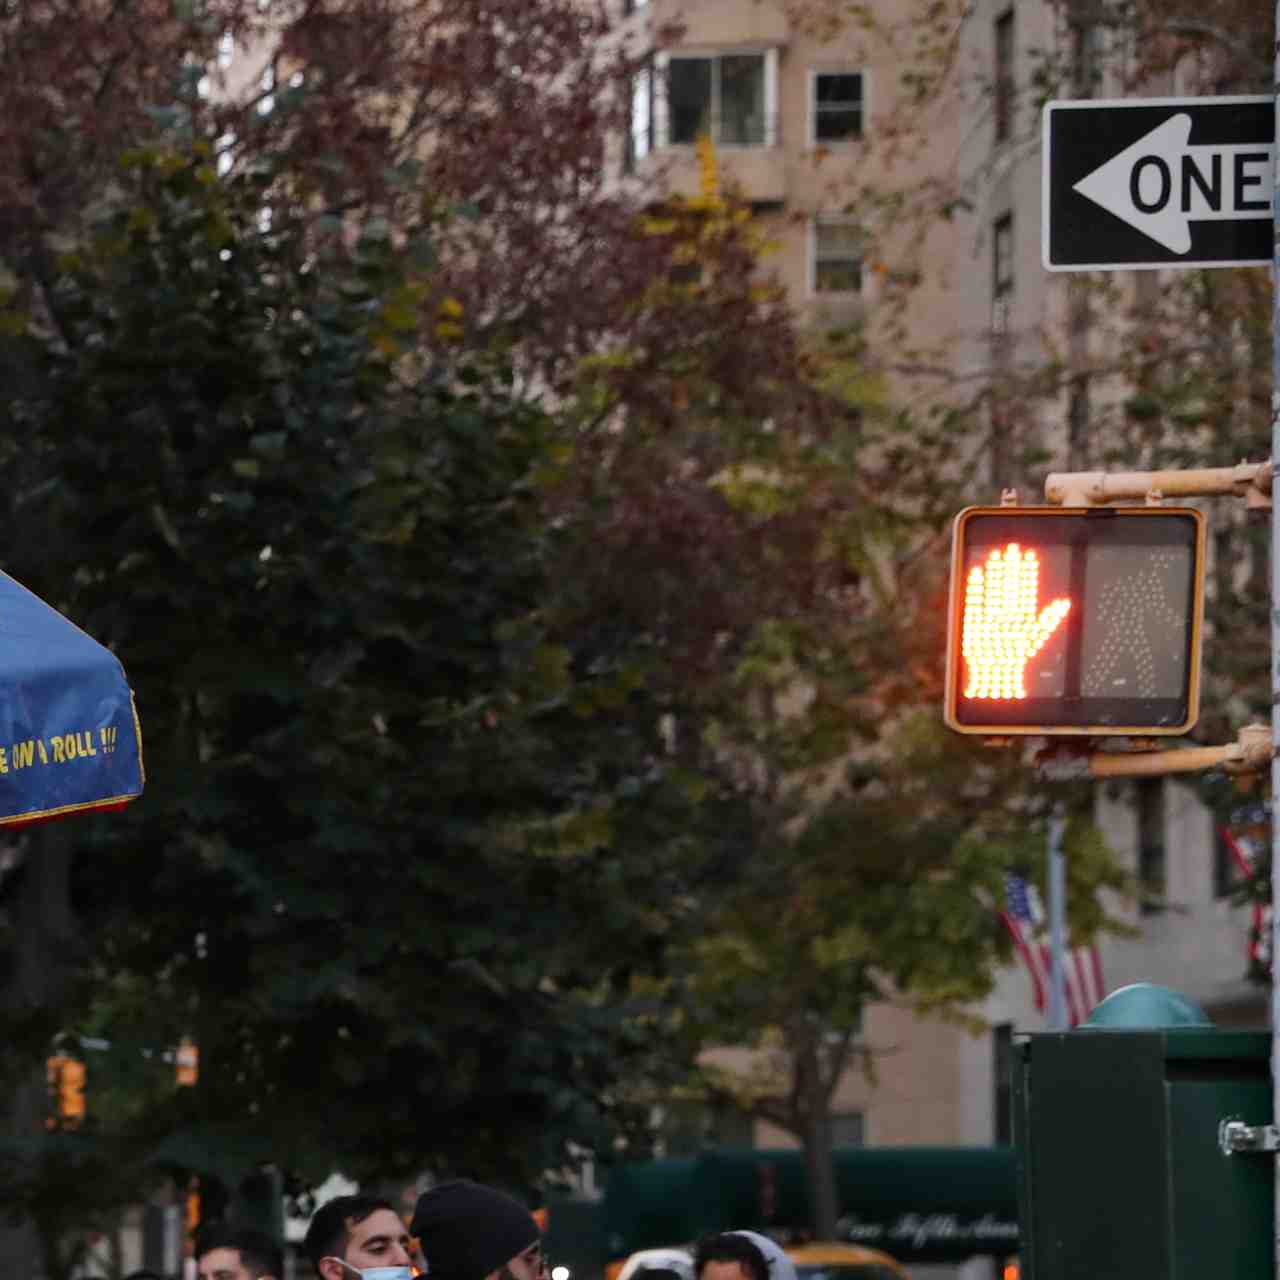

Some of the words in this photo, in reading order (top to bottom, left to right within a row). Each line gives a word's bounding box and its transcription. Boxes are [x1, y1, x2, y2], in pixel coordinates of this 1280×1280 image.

[1129, 152, 1270, 214] ONE
[12, 742, 37, 769] ON
[38, 740, 51, 765] A
[51, 732, 98, 763] ROLL
